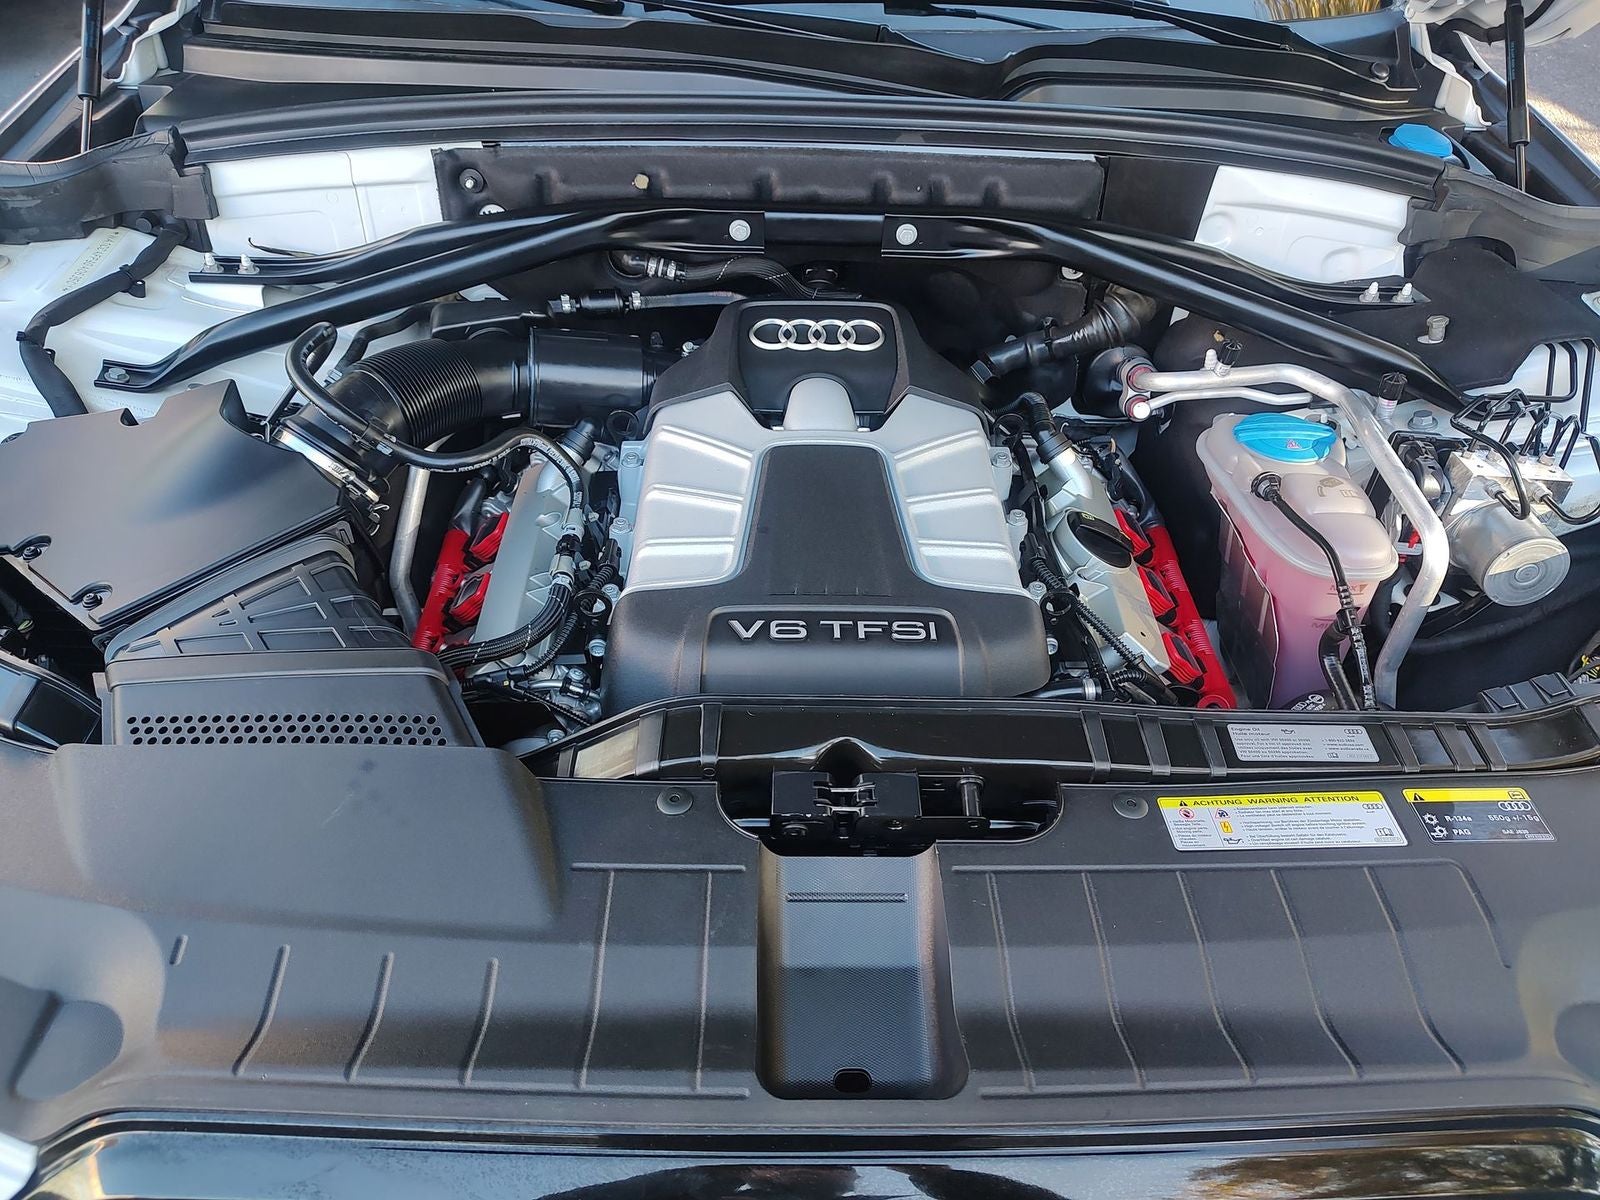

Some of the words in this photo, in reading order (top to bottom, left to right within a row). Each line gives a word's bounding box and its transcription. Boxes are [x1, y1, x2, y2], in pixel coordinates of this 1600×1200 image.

[728, 620, 808, 640] V6
[820, 620, 938, 642] TFSI
[1247, 797, 1299, 805] WARNING
